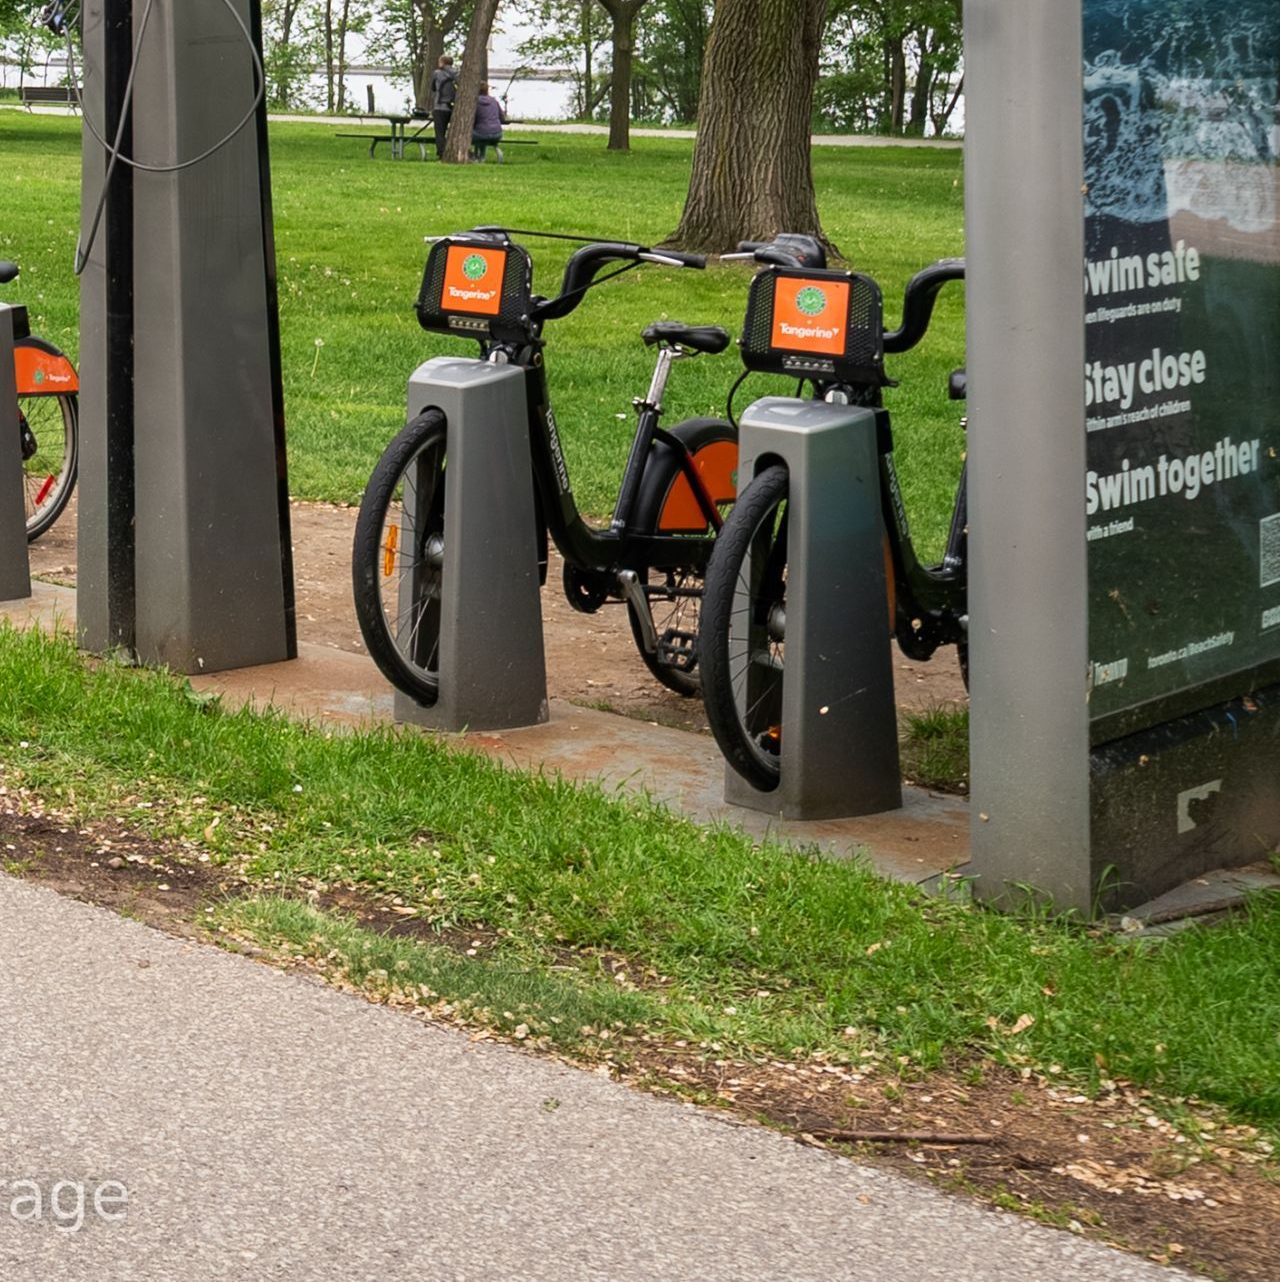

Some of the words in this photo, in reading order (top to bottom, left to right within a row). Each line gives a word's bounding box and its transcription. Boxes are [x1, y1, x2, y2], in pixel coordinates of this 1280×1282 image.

[1085, 246, 1144, 296] wim
[1146, 239, 1200, 287] safe
[448, 286, 490, 300] Tangerine
[780, 323, 833, 339] Tangerine
[1139, 347, 1207, 394] close
[1086, 458, 1155, 515] Swim
[1157, 436, 1260, 500] together
